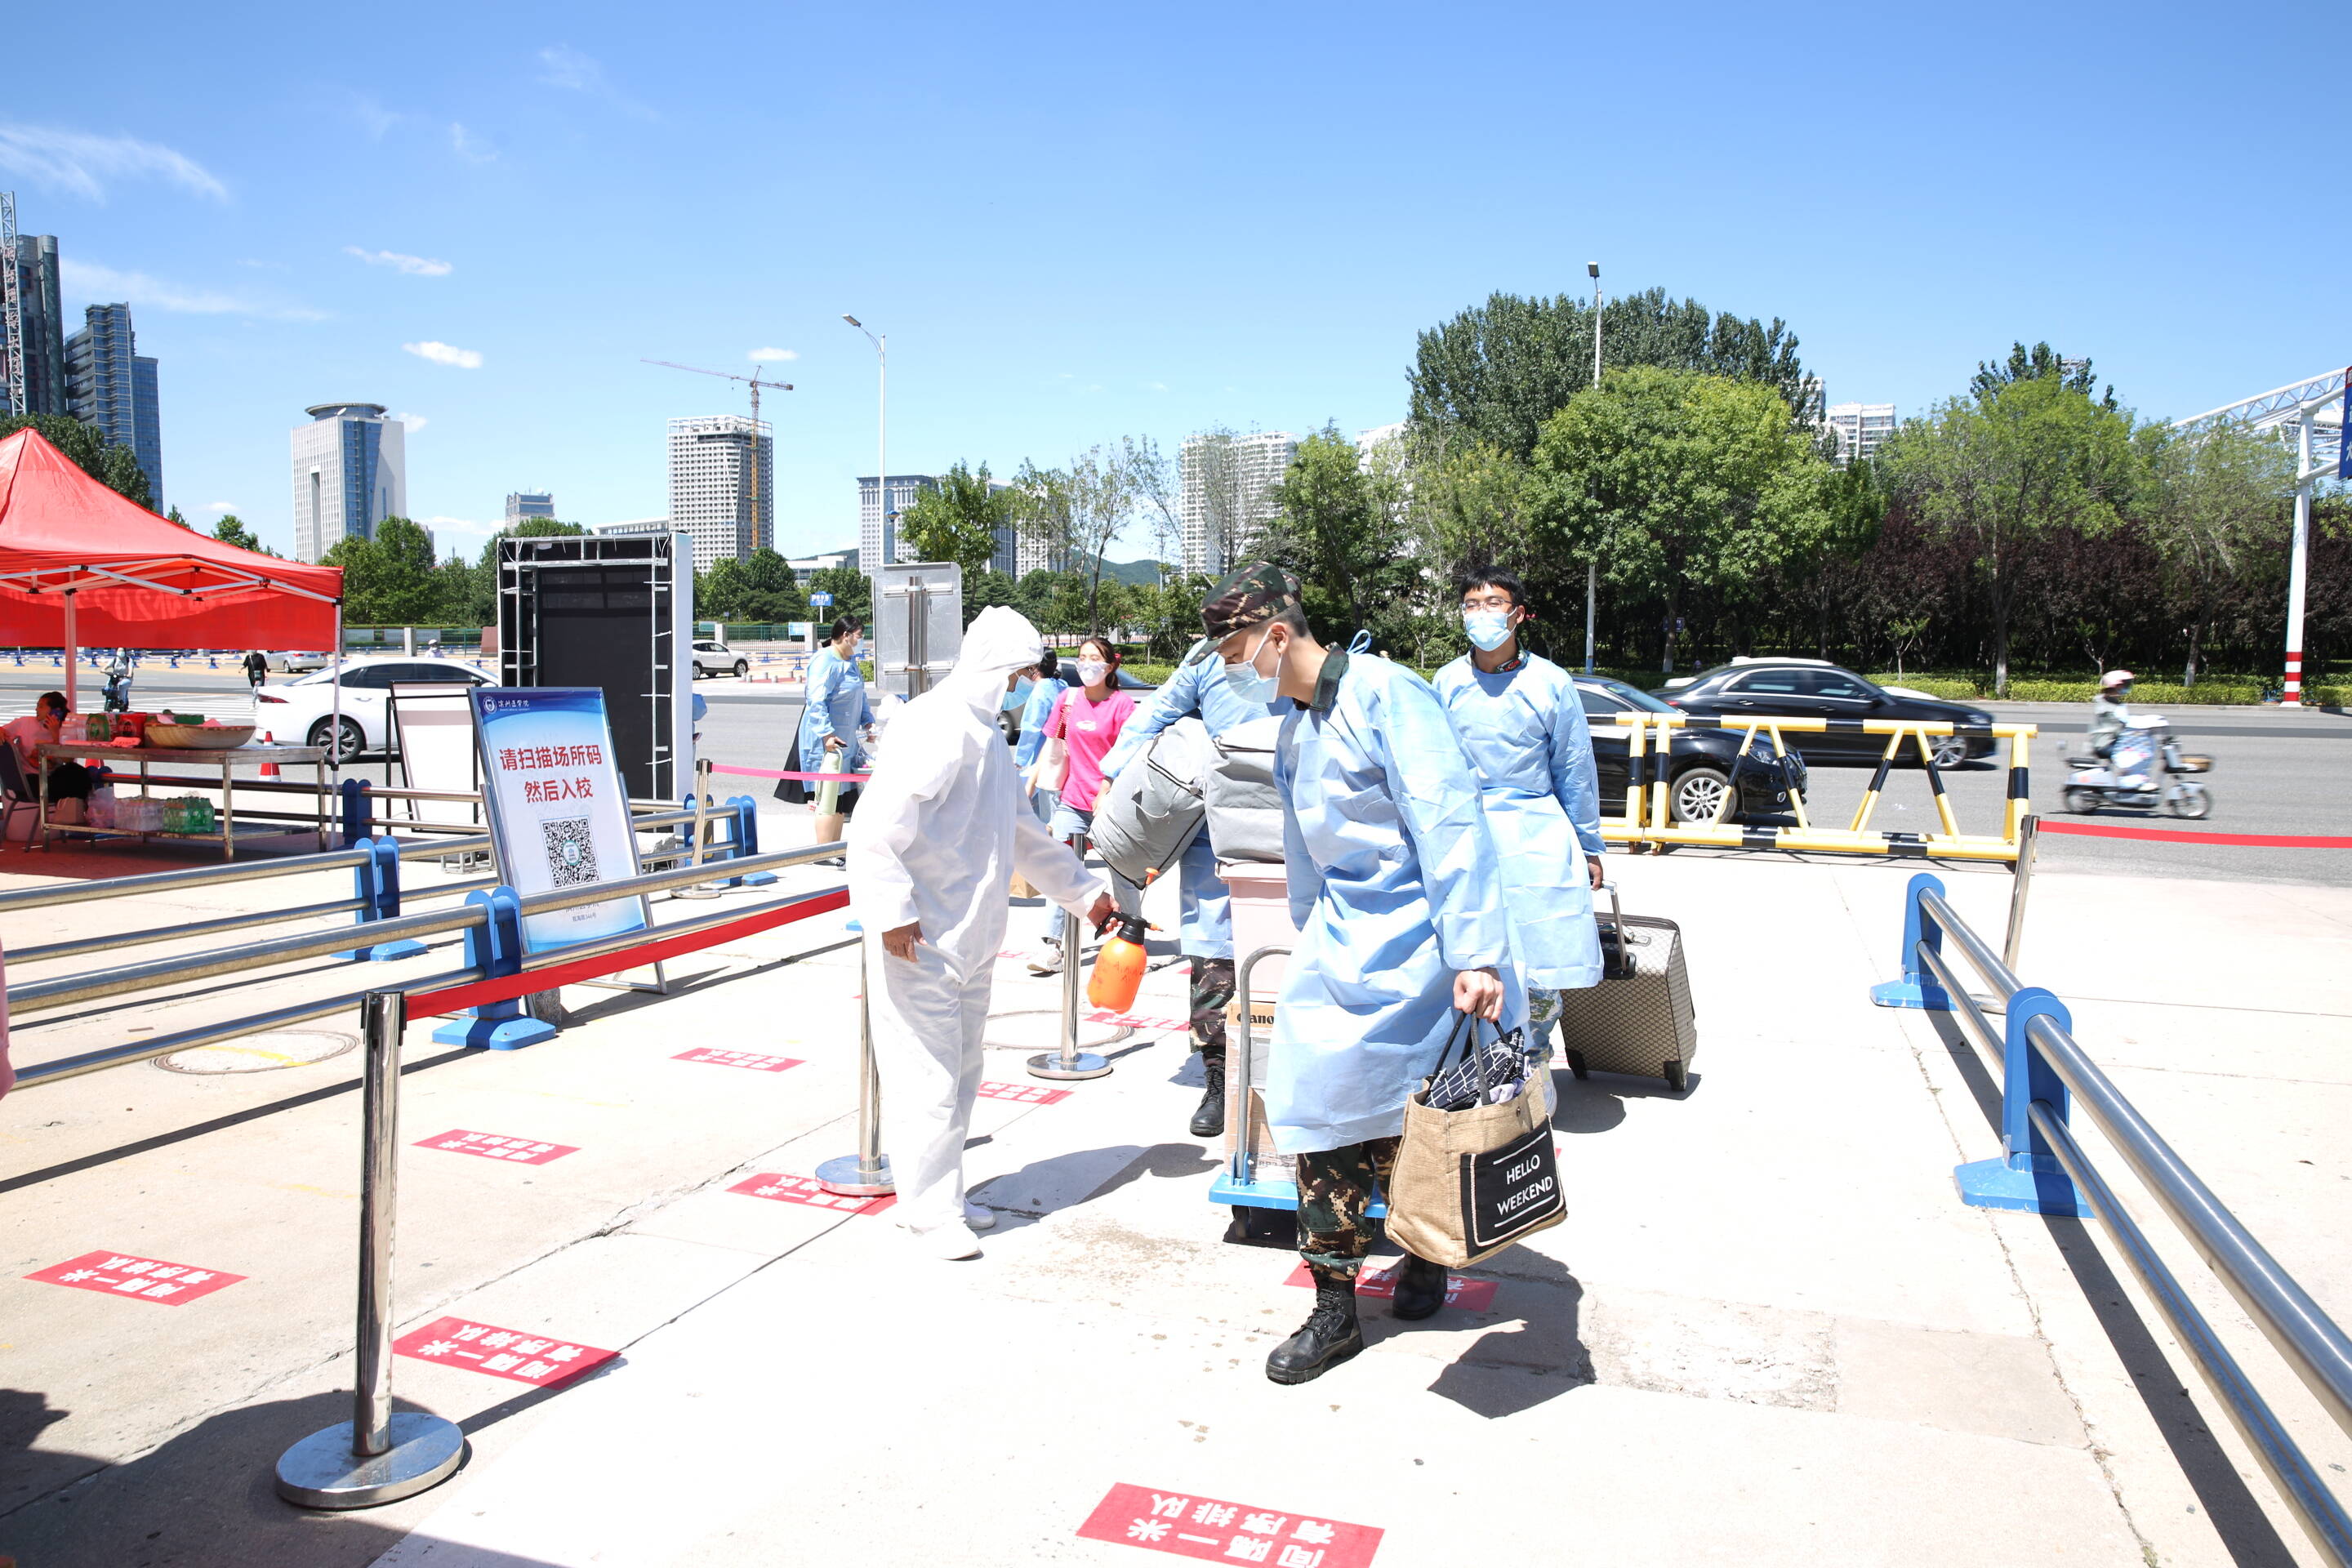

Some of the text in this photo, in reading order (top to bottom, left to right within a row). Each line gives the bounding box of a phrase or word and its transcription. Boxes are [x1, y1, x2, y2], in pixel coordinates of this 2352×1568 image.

[499, 744, 603, 771] 请扫描场所码
[524, 777, 594, 804] 然后入校
[1236, 1013, 1274, 1025] ano
[1506, 1154, 1541, 1185] HELLO
[1496, 1176, 1553, 1216] WEEKEND
[417, 1339, 560, 1379] 间隔一米
[451, 1325, 584, 1362] 有序排队
[1151, 1494, 1335, 1544] 有序排队
[1126, 1517, 1325, 1568] 间隔一米
